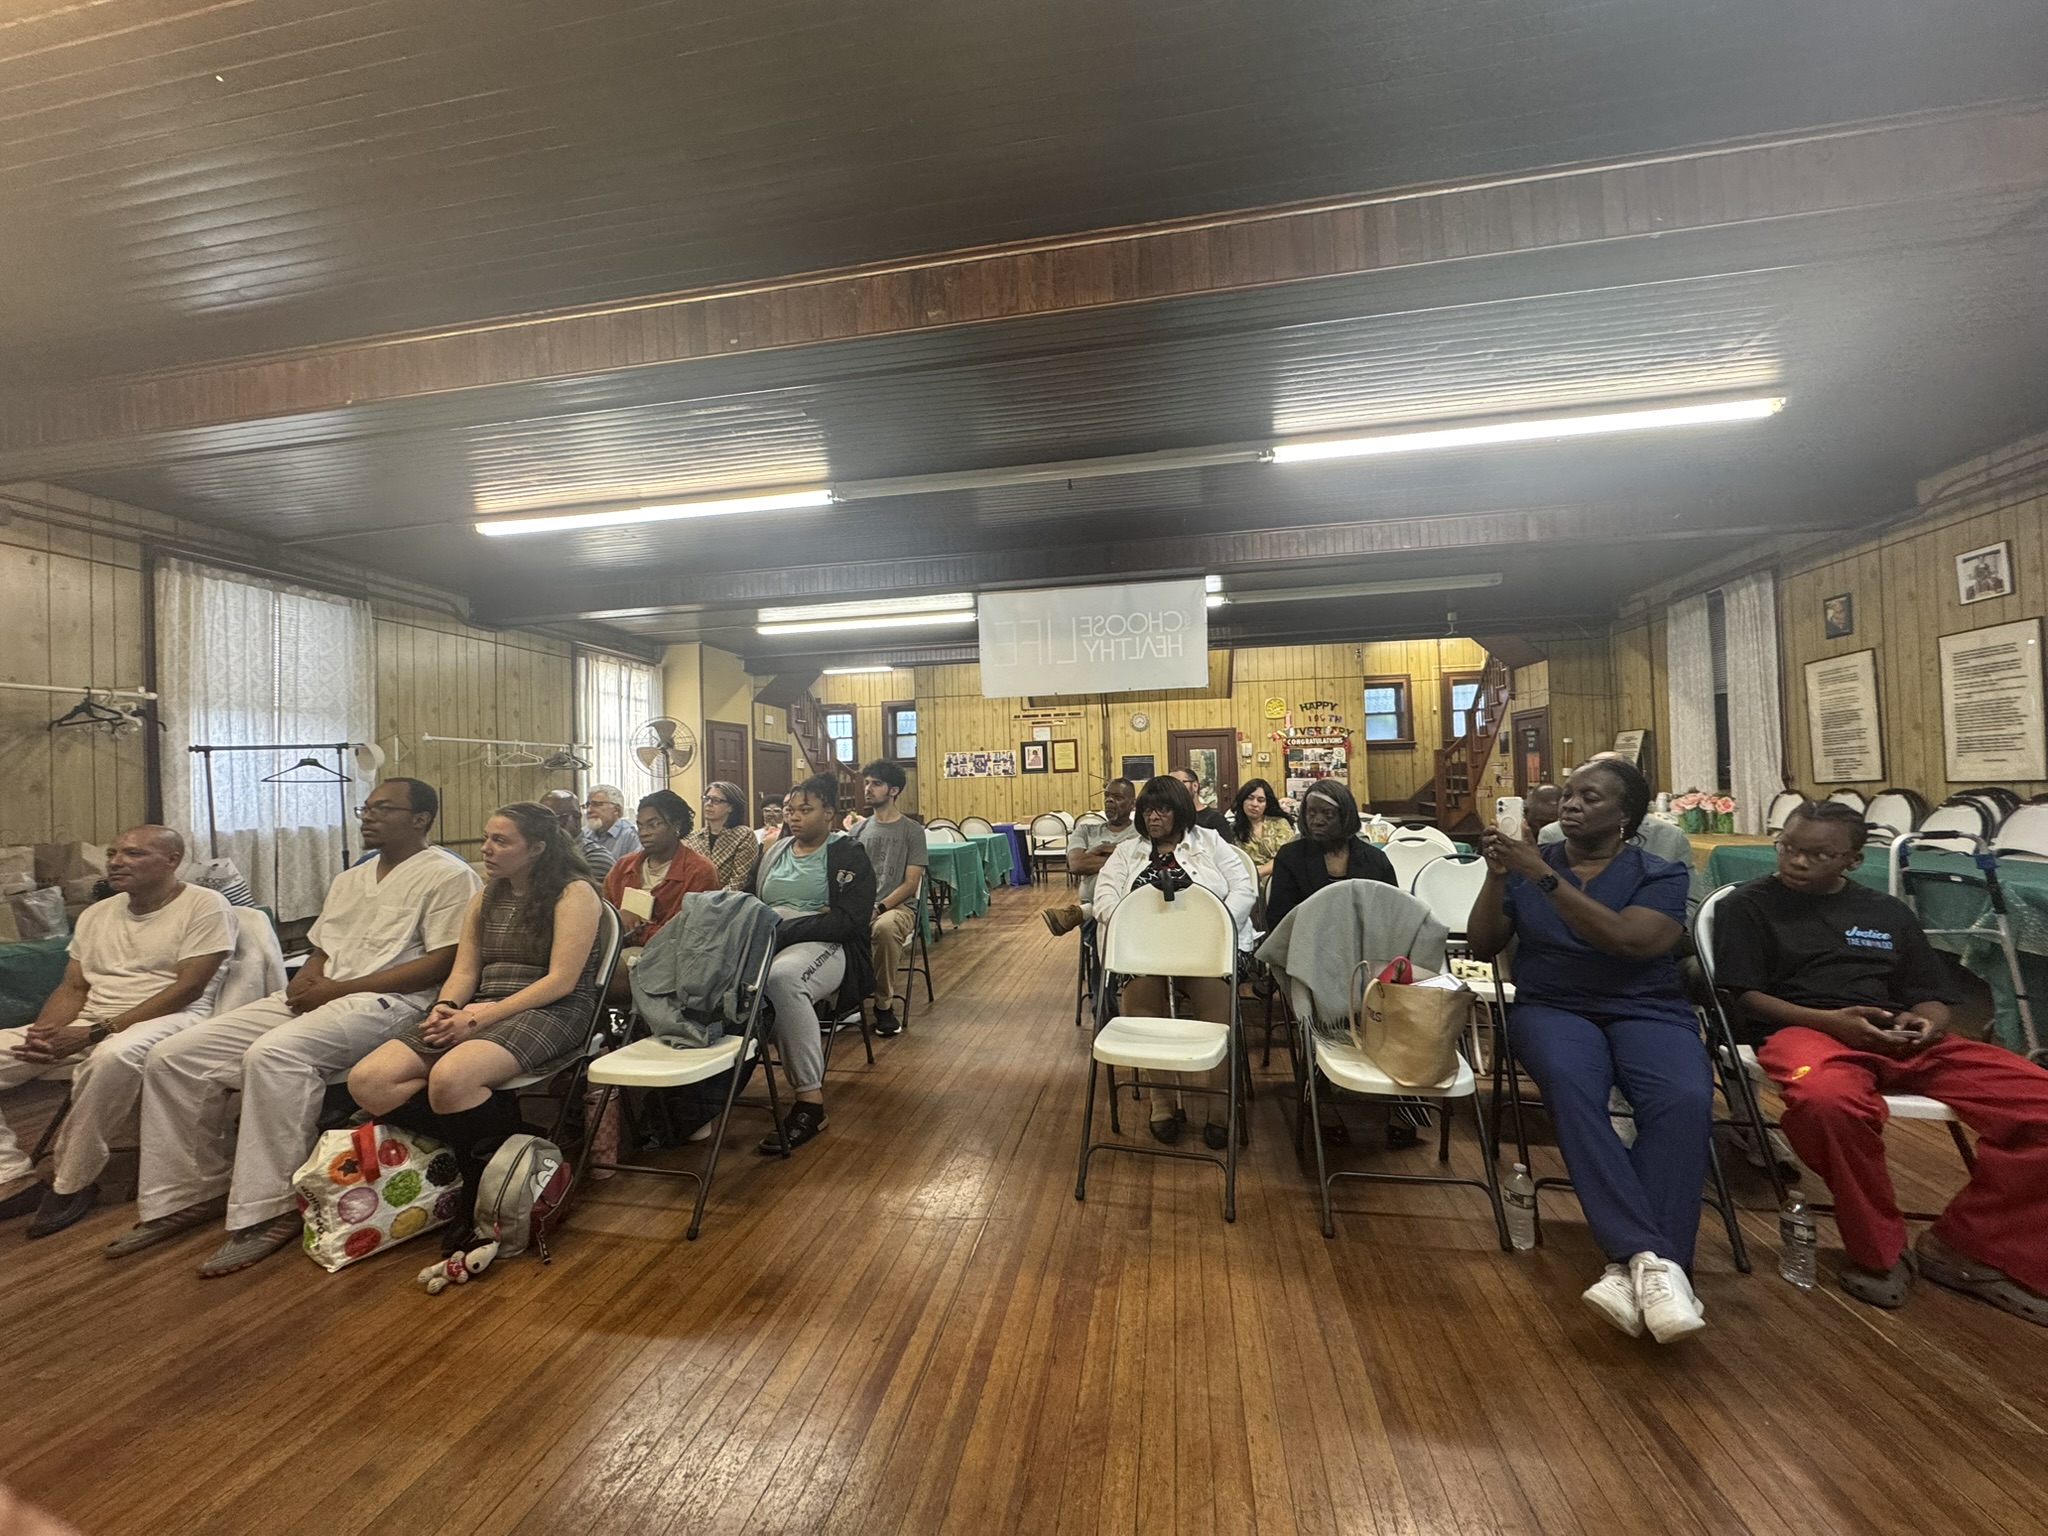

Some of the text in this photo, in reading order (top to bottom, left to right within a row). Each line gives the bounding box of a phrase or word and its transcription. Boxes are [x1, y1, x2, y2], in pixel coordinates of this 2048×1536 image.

[1299, 701, 1338, 712] HAPPY
[1287, 738, 1344, 746] CONGRATULATIONS
[1845, 926, 1892, 940] Justice
